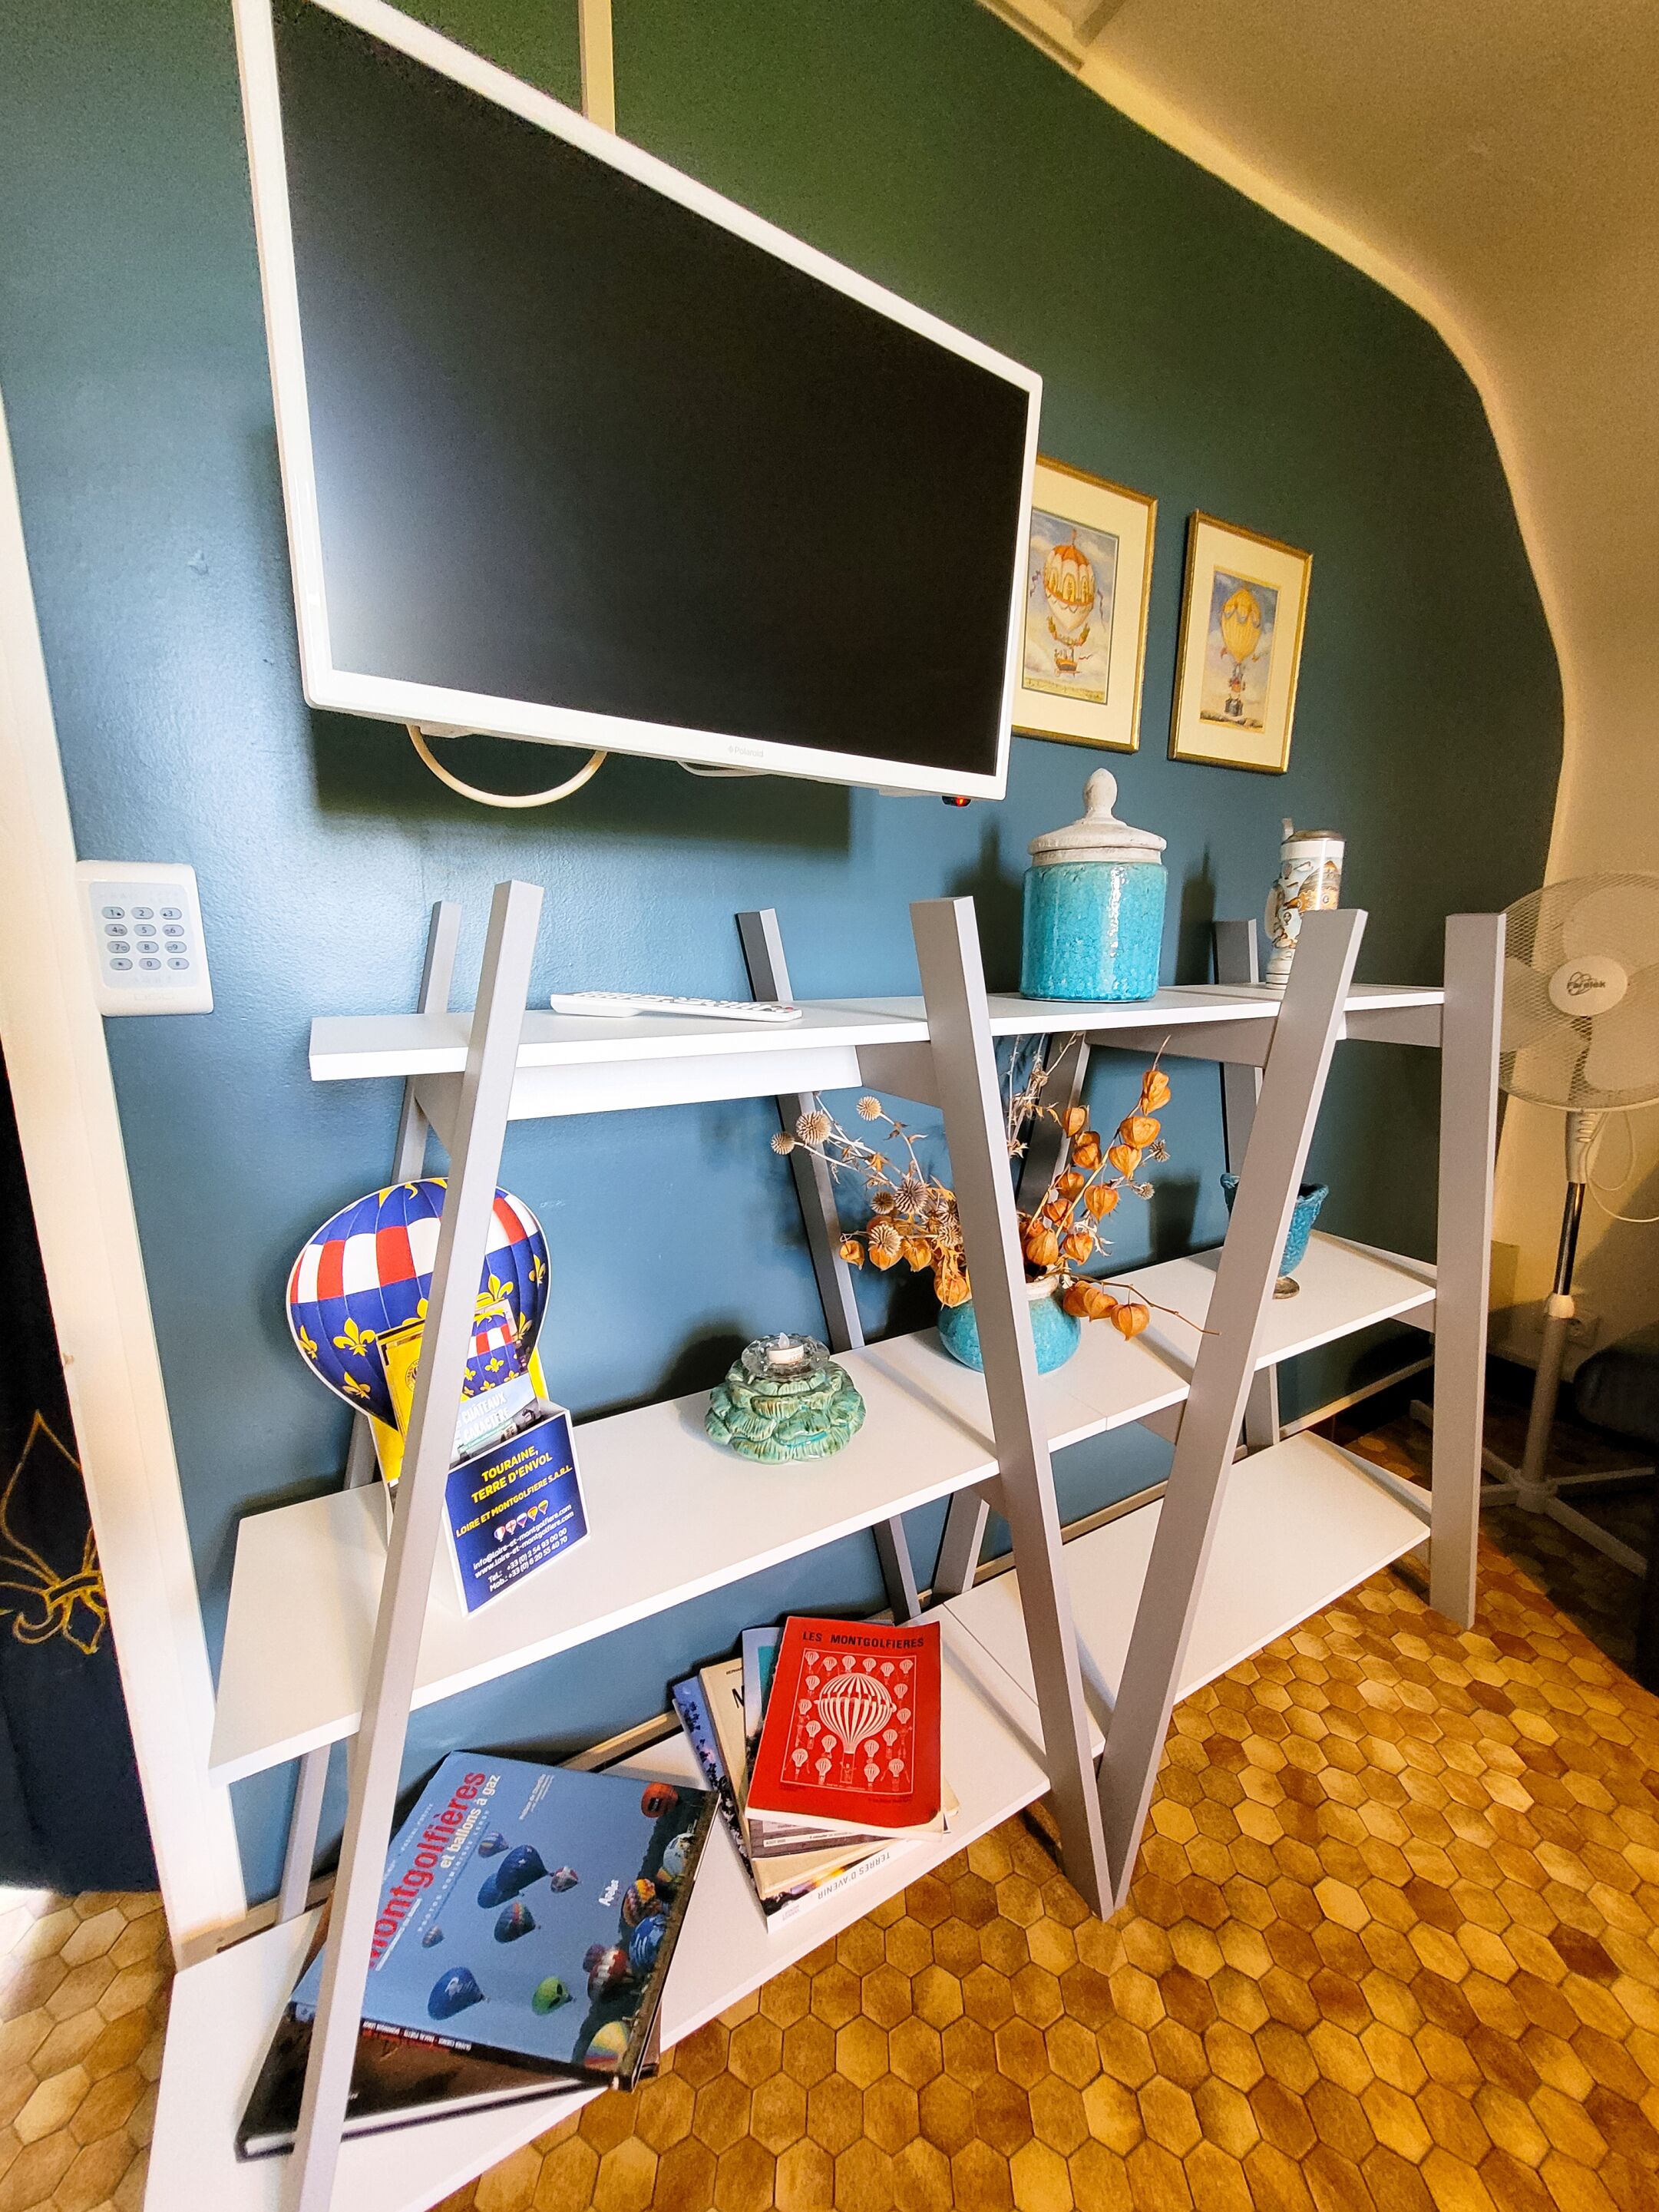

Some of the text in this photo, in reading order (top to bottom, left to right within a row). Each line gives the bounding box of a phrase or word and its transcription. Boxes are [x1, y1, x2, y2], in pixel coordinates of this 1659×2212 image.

[735, 746, 764, 758] Polaroid
[471, 1452, 553, 1503] TERRE D'ENVOL
[481, 1445, 539, 1482] TOURAINE,
[455, 1517, 481, 1538] LOIRE
[480, 1511, 491, 1524] ET
[491, 1477, 548, 1517] MONTGOLFIERE
[473, 1504, 572, 1570] info@loire-et-montgolfiere.com
[474, 1511, 574, 1579] www.loire-et-montgolfiere.com
[507, 1559, 519, 1570] +33
[518, 1552, 527, 1564] (0)
[532, 1546, 541, 1556] 54
[540, 1539, 550, 1549] 93
[550, 1533, 558, 1542] 00
[558, 1527, 567, 1537] 00
[508, 1566, 521, 1579] +33
[520, 1561, 529, 1572] (0)
[534, 1551, 544, 1562] 20
[543, 1546, 551, 1556] 55
[560, 1536, 568, 1545] 70
[802, 1631, 924, 1649] LES MONTGOLFIERES
[440, 1774, 501, 1868] et ballons à gaz
[818, 1851, 891, 1900] TERRES D'AVENIR
